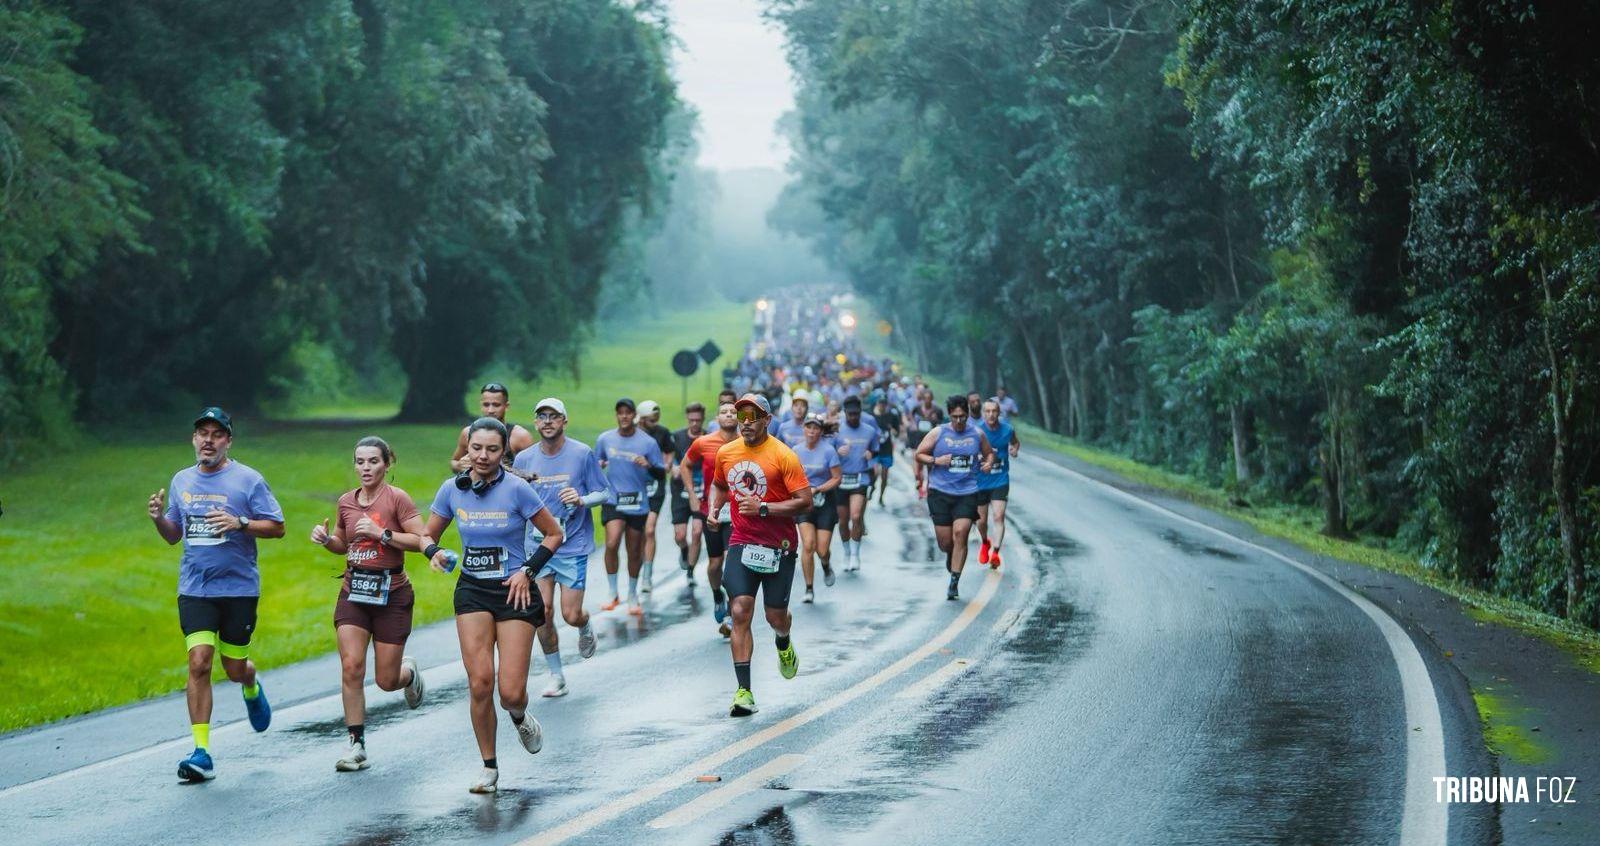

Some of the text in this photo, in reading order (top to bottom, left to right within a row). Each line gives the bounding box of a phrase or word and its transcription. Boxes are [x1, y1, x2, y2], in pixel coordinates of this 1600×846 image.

[465, 555, 495, 566] 5001
[750, 552, 766, 562] 192
[351, 579, 378, 592] 5584
